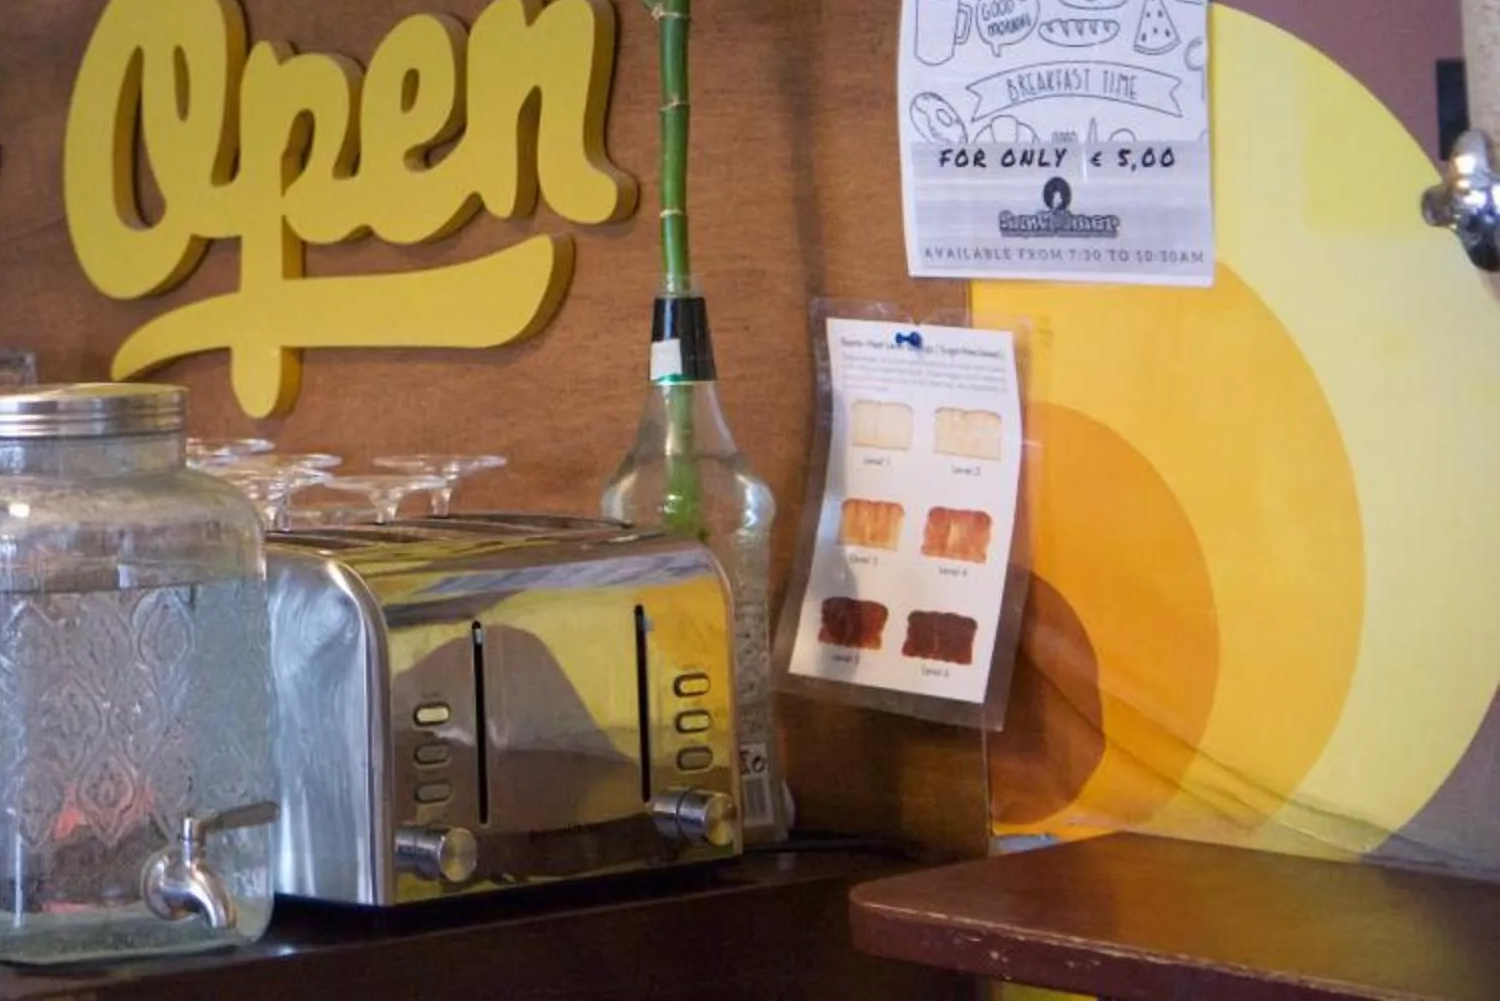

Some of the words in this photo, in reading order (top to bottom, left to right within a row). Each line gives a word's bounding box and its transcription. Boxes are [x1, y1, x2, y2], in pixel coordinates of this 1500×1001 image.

[1006, 69, 1091, 100] BREAKFAST
[1101, 72, 1139, 100] TIME
[939, 149, 987, 168] FOR
[1001, 148, 1068, 168] ONLY
[1118, 149, 1176, 171] 5,00
[925, 247, 1011, 260] AVAILABLE
[1018, 248, 1063, 260] FROM
[1107, 248, 1130, 262] TO
